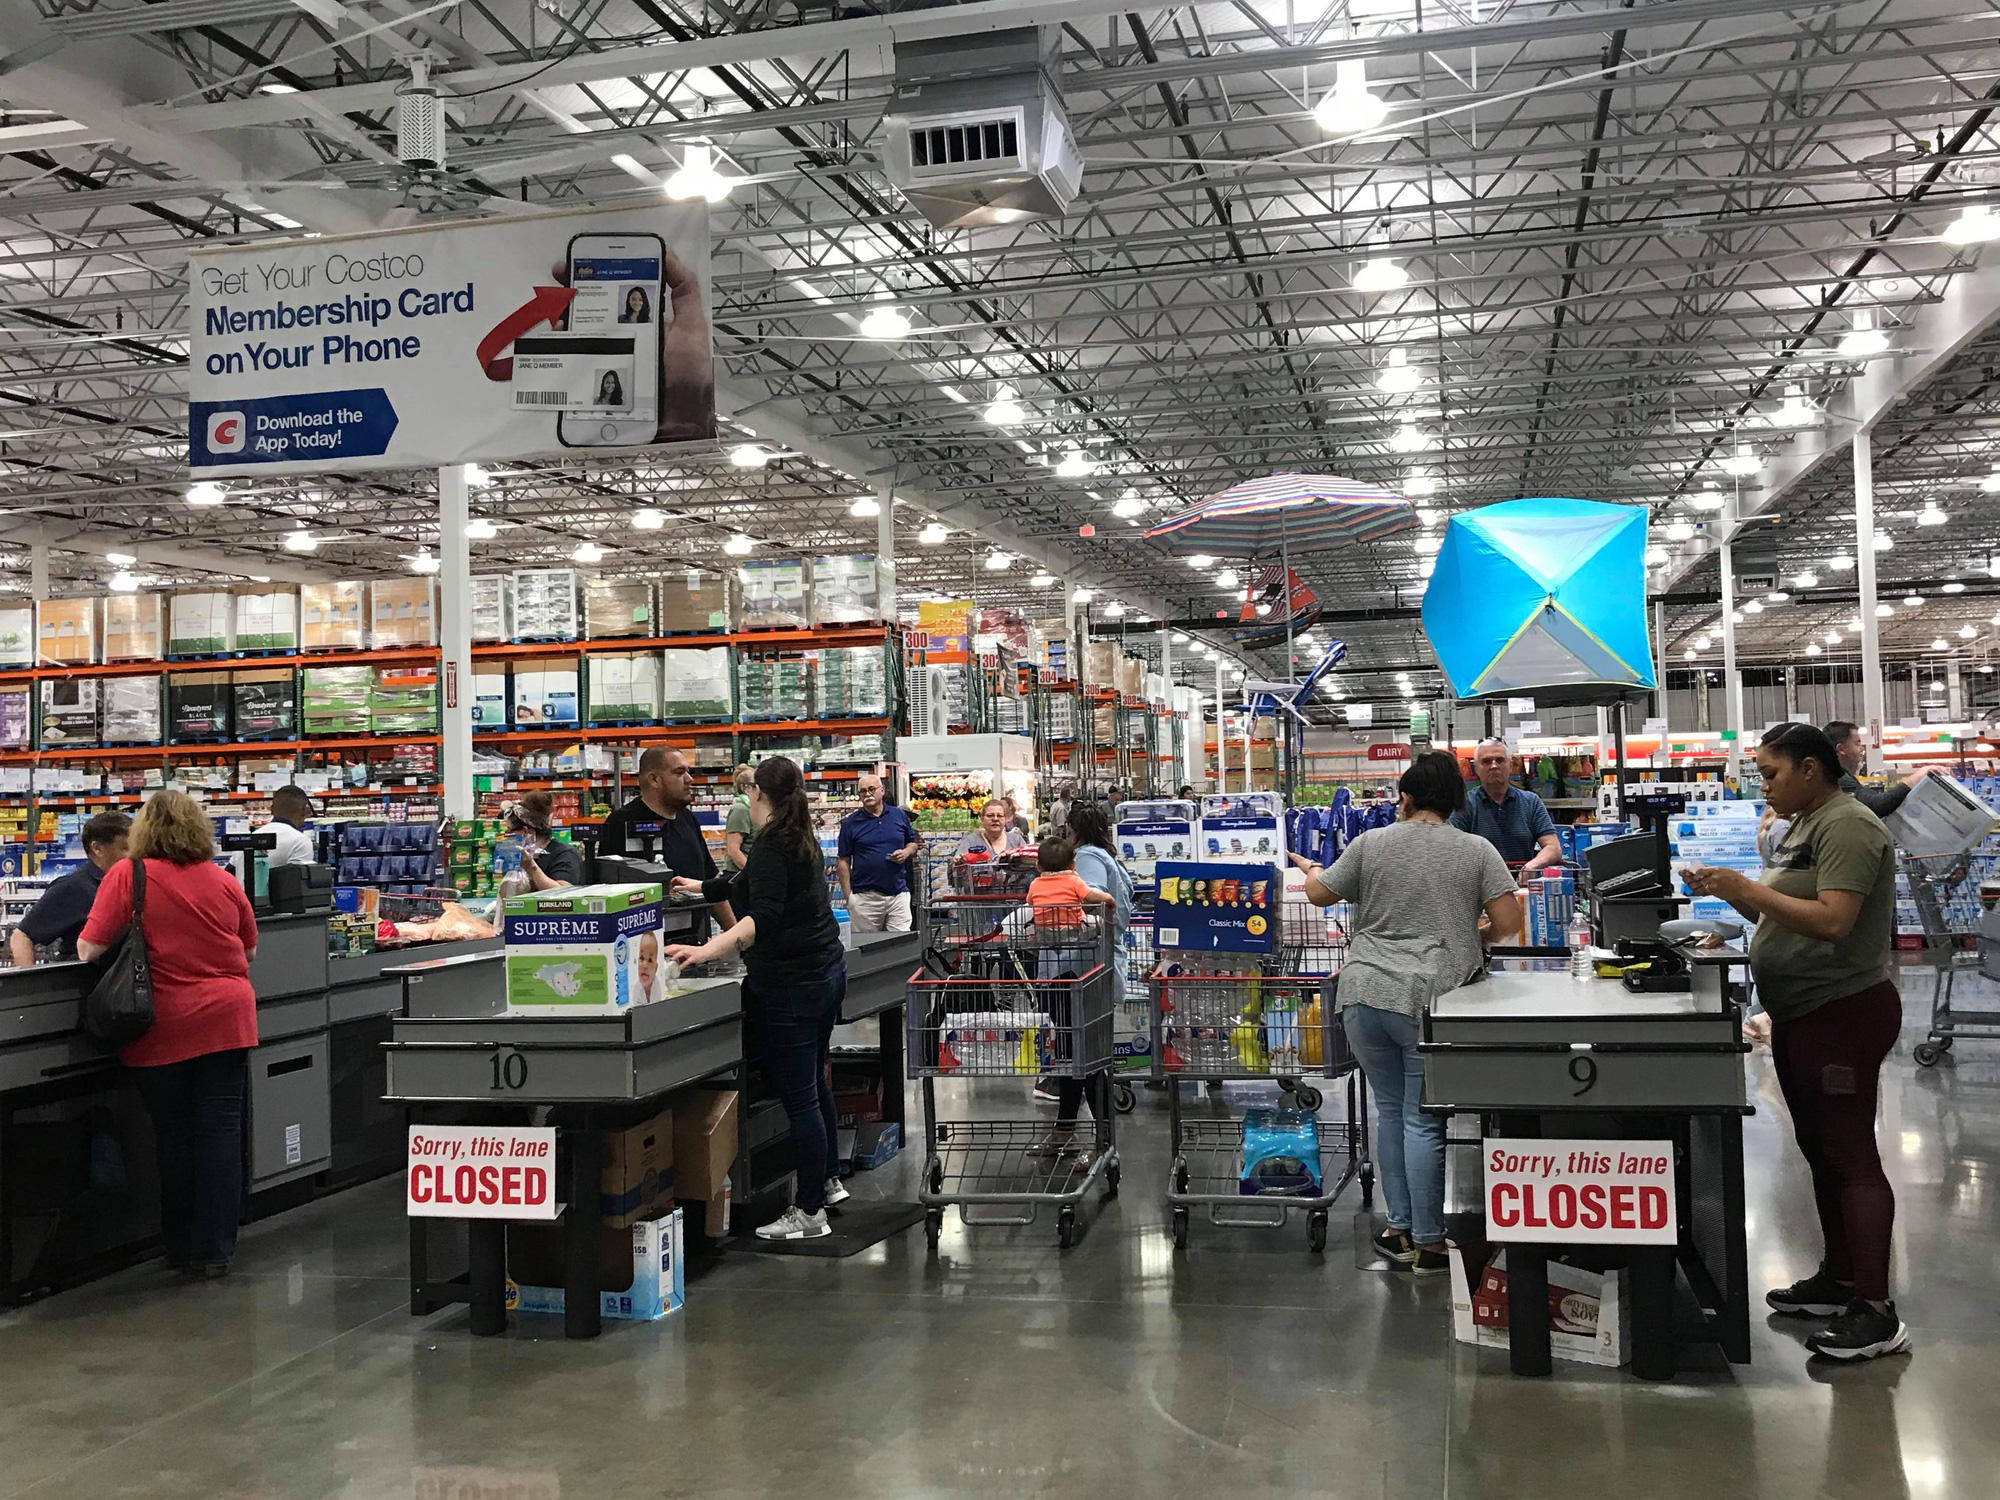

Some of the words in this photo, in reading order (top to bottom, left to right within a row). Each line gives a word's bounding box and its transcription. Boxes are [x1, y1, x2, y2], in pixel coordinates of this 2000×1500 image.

[201, 267, 249, 296] Get
[256, 261, 317, 292] Your
[325, 252, 424, 285] Costco
[205, 292, 392, 336] Membership
[398, 282, 474, 319] Card
[205, 353, 244, 376] on
[243, 342, 315, 372] Your
[322, 334, 421, 365] Phone
[256, 409, 333, 431] Download
[337, 408, 363, 424] the
[255, 435, 289, 454] App
[293, 430, 342, 450] Today!
[905, 632, 928, 648] 300
[1040, 670, 1057, 684] 304
[1085, 684, 1100, 696] 306
[182, 704, 212, 712] Beautyrest
[246, 702, 278, 710] Beautyrest
[1152, 704, 1166, 713] 310
[1178, 712, 1188, 720] 312
[1377, 748, 1402, 758] DAIRY
[514, 919, 600, 936] SUPRÊME
[618, 908, 657, 932] SUPRÊME
[1208, 918, 1232, 927] Classic
[1232, 920, 1246, 928] Mix
[1251, 920, 1262, 928] 54
[490, 1053, 528, 1090] 10
[1568, 1056, 1598, 1097] 9
[411, 1135, 466, 1160] Sorry,
[470, 1136, 506, 1157] this
[508, 1138, 548, 1158] lane
[1490, 1150, 1561, 1179] Sorry,
[1568, 1150, 1611, 1174] this
[1618, 1152, 1668, 1175] lane
[410, 1164, 547, 1206] CLOSED
[1490, 1183, 1668, 1230] CLOSED
[634, 1246, 646, 1254] 158
[506, 1286, 517, 1300] de
[1603, 1331, 1612, 1347] 3
